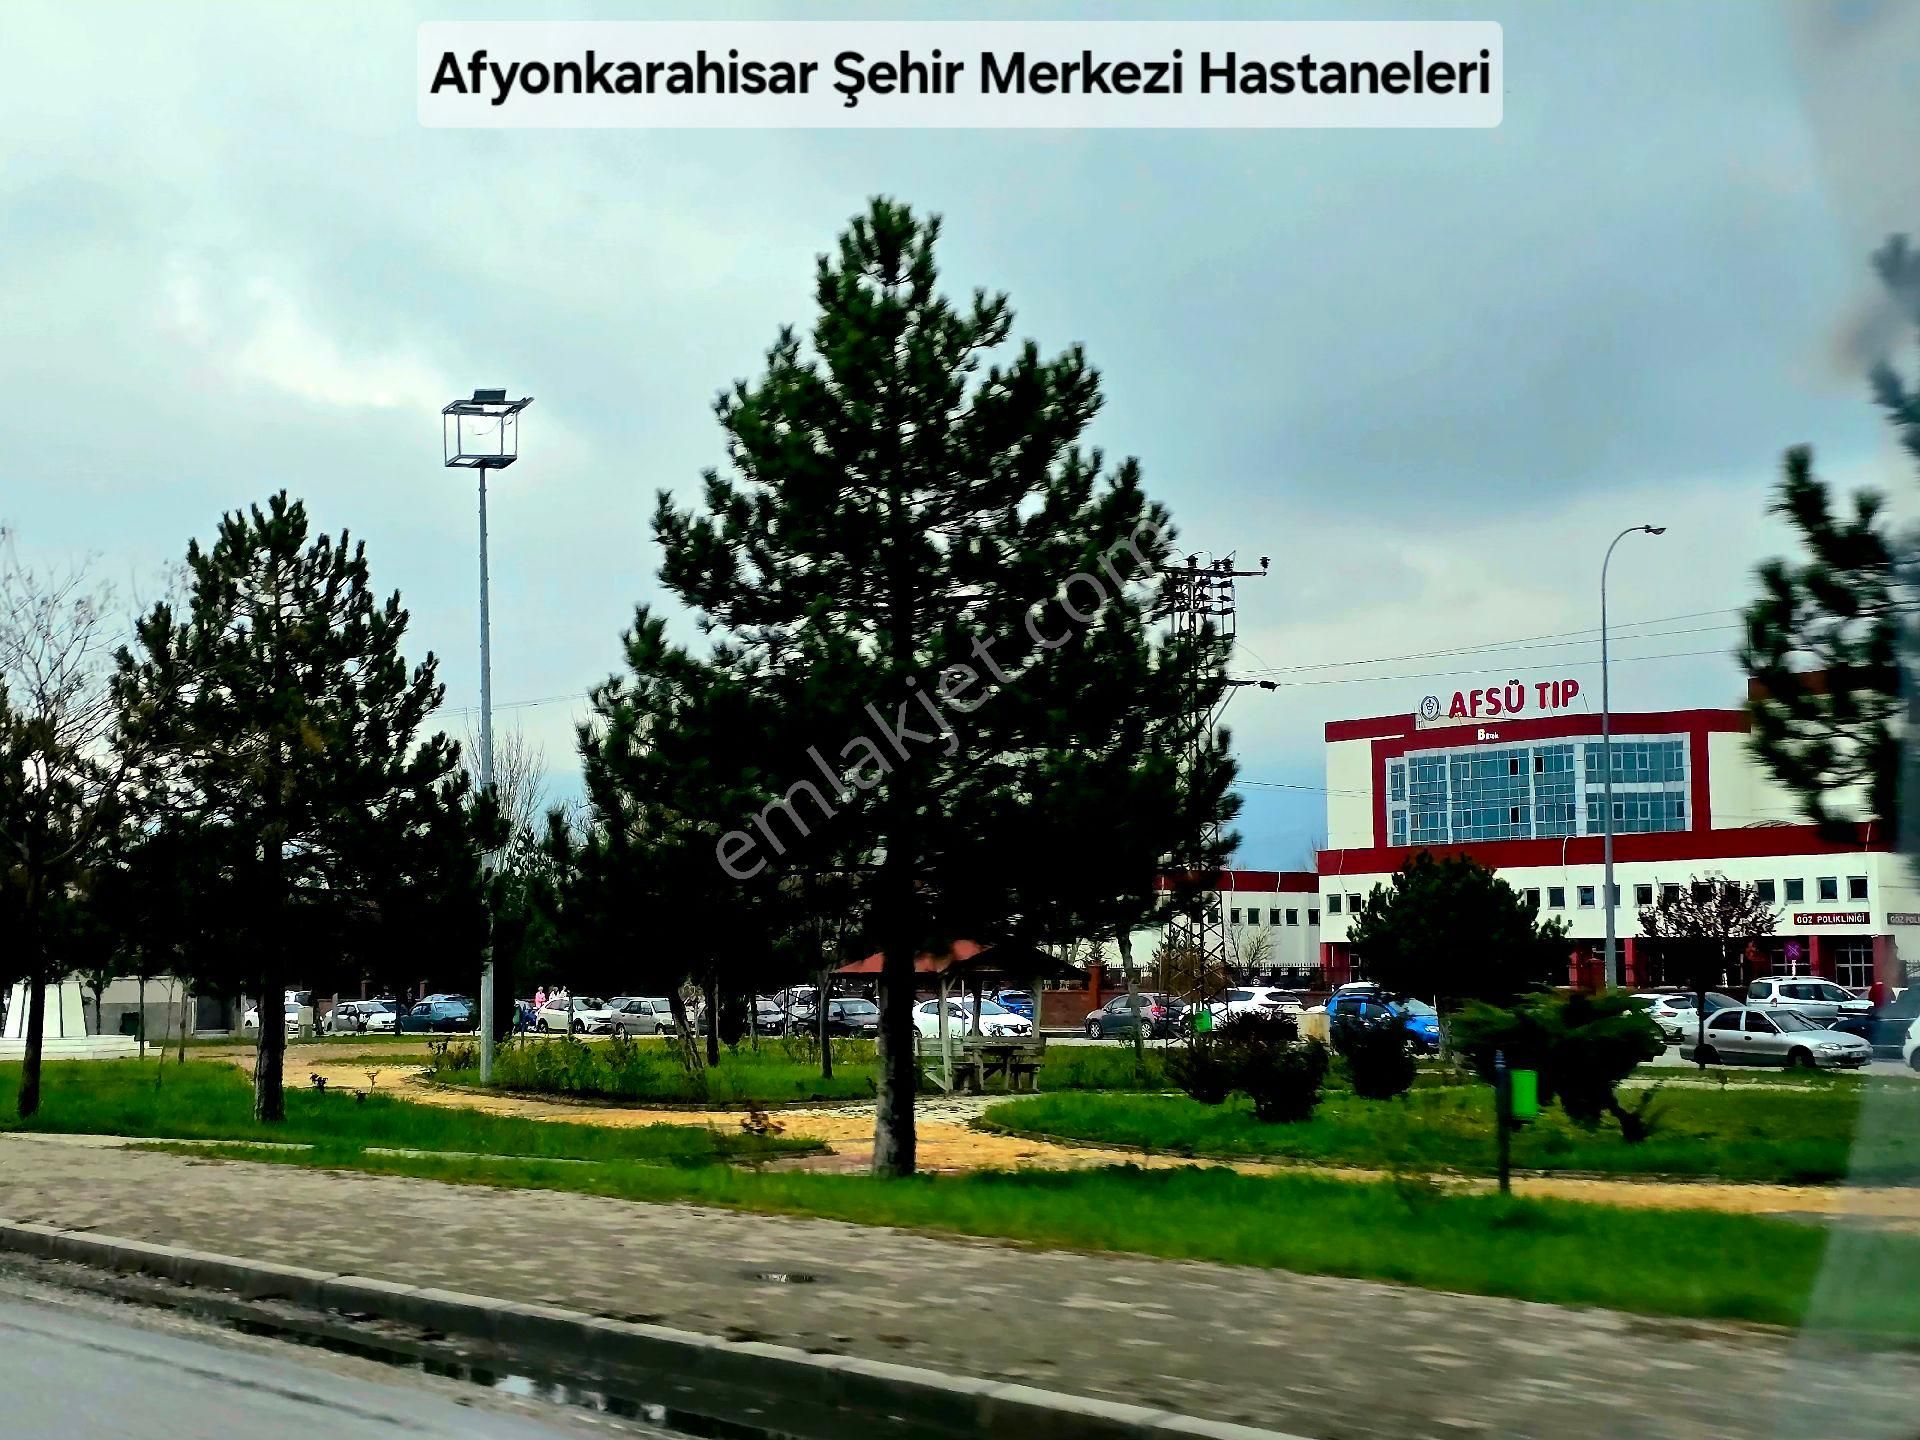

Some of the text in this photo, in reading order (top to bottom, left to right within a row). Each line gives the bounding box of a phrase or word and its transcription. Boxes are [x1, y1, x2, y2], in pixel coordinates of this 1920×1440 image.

[1449, 679, 1579, 719] AFSÜ TIP
[1797, 914, 1813, 924] GÖZ
